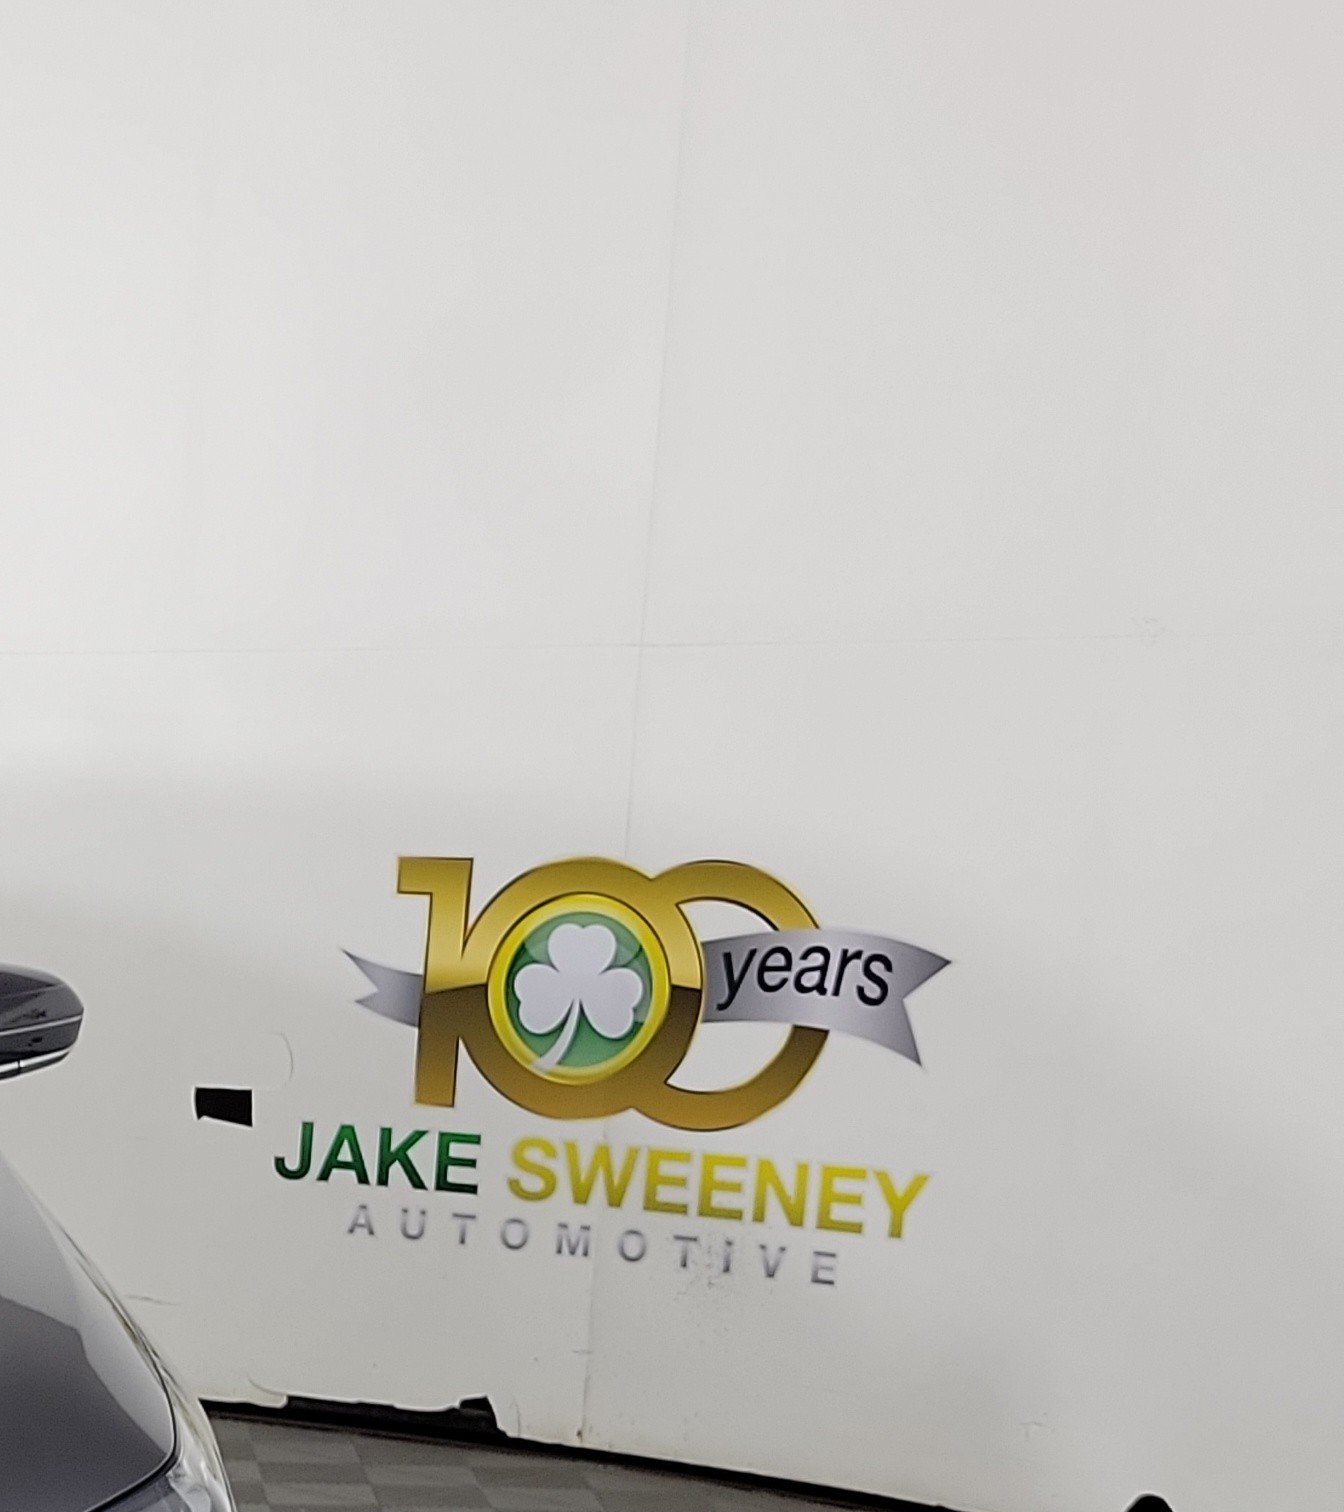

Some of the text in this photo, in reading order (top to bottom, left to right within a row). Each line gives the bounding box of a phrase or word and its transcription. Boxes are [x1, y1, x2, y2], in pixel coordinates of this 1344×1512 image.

[397, 856, 894, 1132] 100 years
[273, 1121, 929, 1239] JAKE SWEENEY
